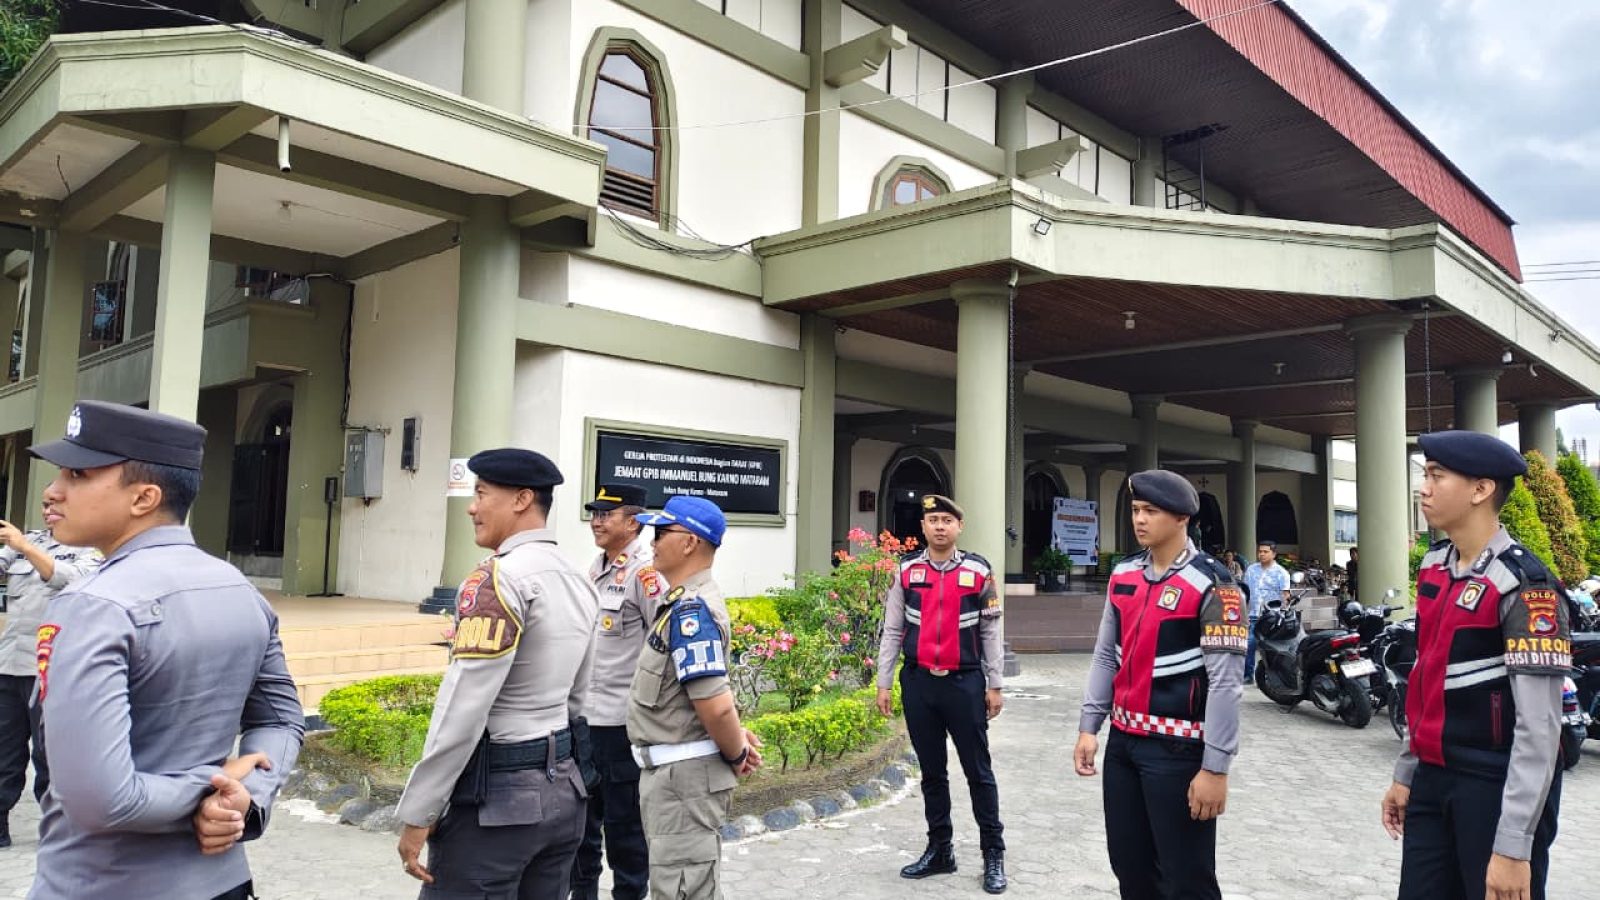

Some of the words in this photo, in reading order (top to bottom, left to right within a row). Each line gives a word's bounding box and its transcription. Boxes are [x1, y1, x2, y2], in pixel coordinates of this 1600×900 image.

[646, 452, 678, 463] PROTESTAN
[686, 455, 713, 466] INDONESIA
[614, 465, 642, 479] JEMAAT
[643, 467, 660, 480] GPIB
[660, 468, 697, 482] IMMANUEL
[698, 471, 717, 483] BUNG
[717, 472, 740, 485] KARNO
[740, 474, 770, 486] MATARAM
[1524, 591, 1556, 600] POLDA
[1530, 651, 1551, 666] DIT
